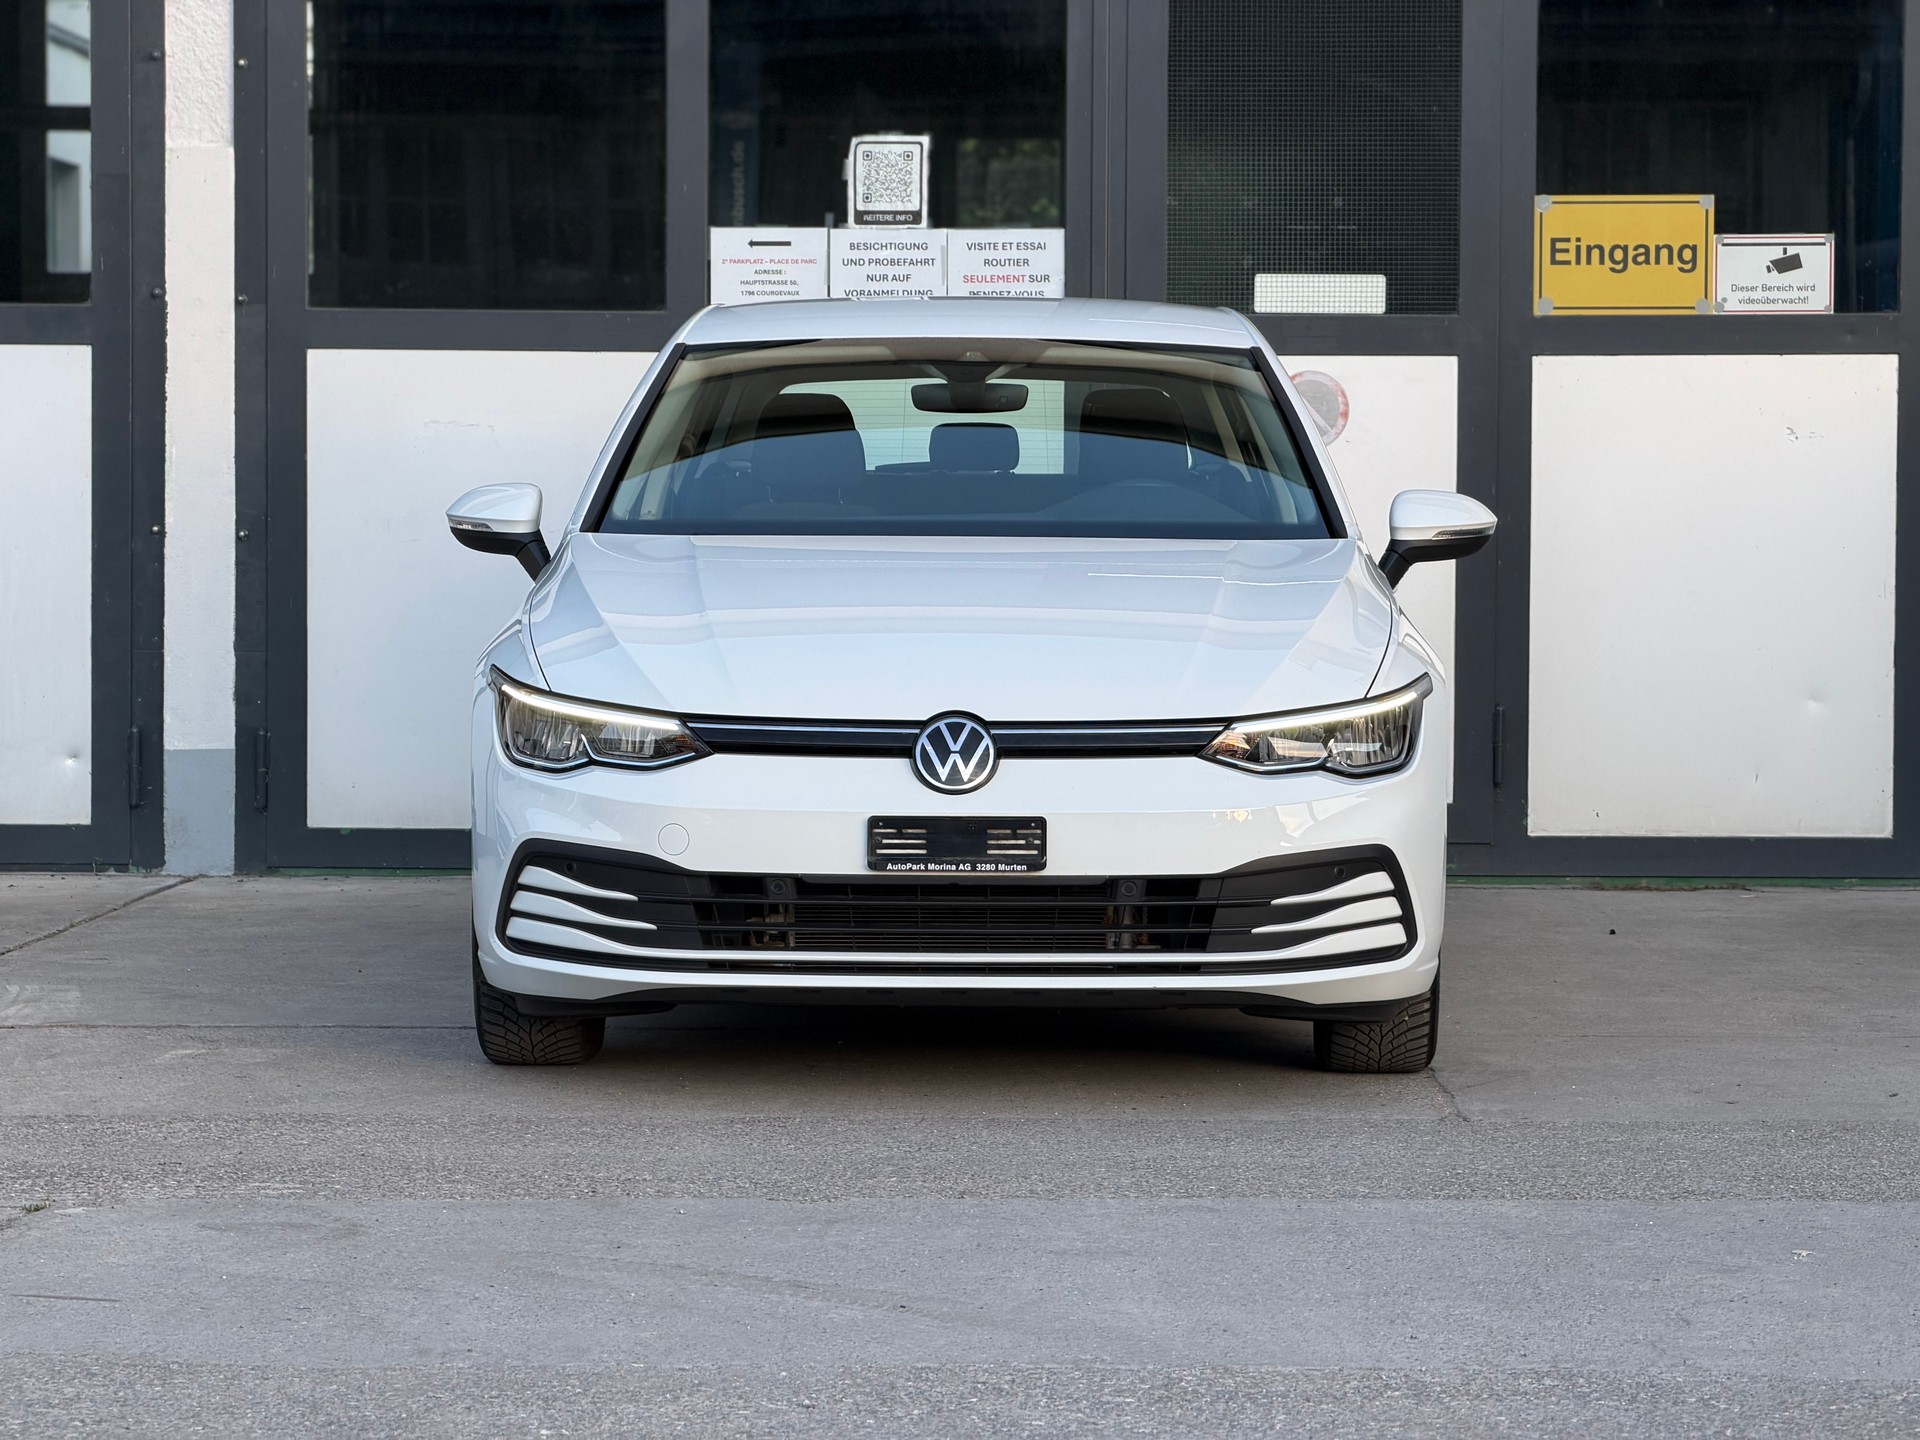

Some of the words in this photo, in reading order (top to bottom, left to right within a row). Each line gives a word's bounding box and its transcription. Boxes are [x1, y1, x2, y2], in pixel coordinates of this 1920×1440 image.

[849, 242, 929, 251] BESICHTIGUNG
[966, 242, 999, 251] VISITE
[1001, 242, 1014, 251] ET
[1016, 242, 1046, 251] ESSAI
[1549, 237, 1698, 274] Eingang
[842, 258, 865, 267] UND
[868, 258, 936, 267] PROBEFAHRT
[983, 258, 1030, 267] ROUTIER
[866, 274, 889, 282] NUR
[890, 274, 912, 282] AUF
[963, 274, 1026, 283] SEULEMENT
[1028, 274, 1050, 283] SUR
[1730, 283, 1759, 293] Dieser
[1761, 283, 1794, 293] Bereich
[1795, 283, 1816, 293] wird
[1738, 295, 1809, 306] videoüberwacht!
[886, 862, 925, 871] AutoPark
[927, 862, 956, 871] Morina
[958, 862, 971, 871] AG
[976, 863, 995, 871] 3280
[997, 863, 1027, 871] Murten
